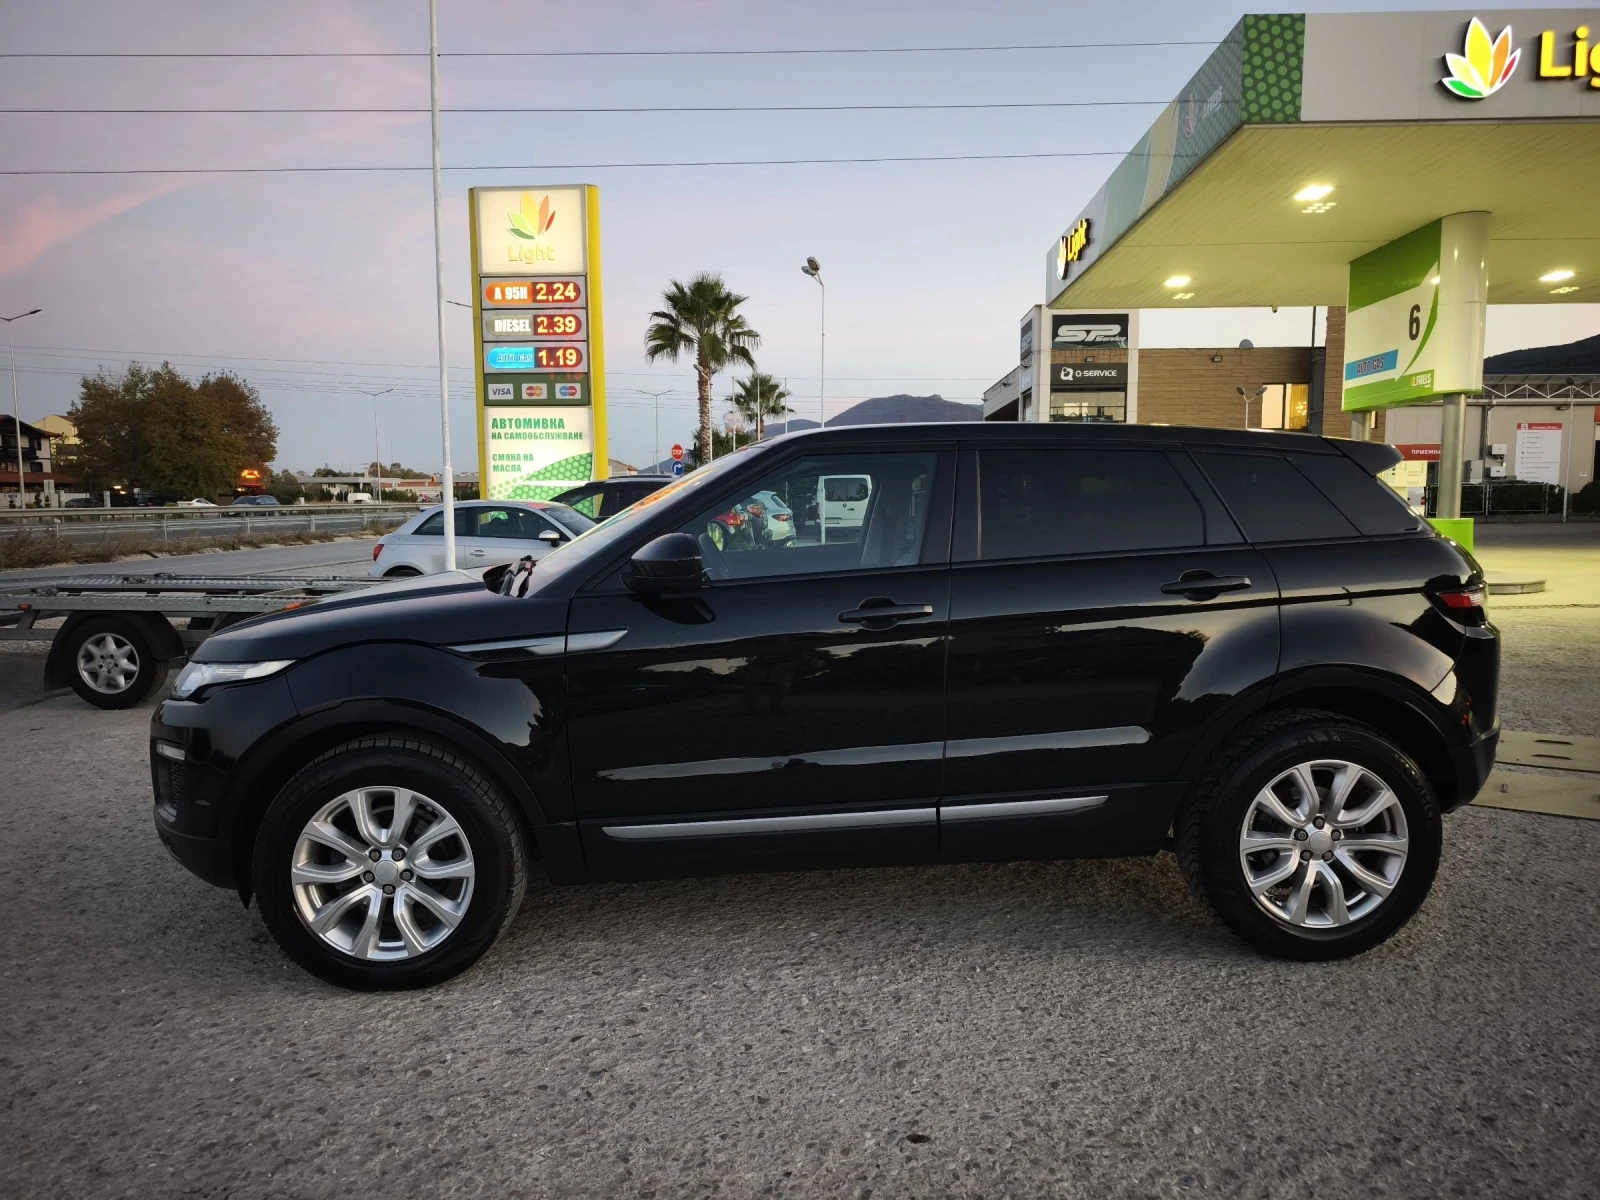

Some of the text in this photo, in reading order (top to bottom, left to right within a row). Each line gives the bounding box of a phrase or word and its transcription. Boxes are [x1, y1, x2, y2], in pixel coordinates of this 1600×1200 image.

[1067, 218, 1088, 262] Light
[507, 243, 556, 265] Light
[494, 316, 577, 333] DIESEL 2.39
[1408, 304, 1421, 341] 6
[1053, 324, 1122, 342] SP
[538, 348, 578, 366] 1.19
[1356, 357, 1384, 375] AUTO GAS
[492, 387, 512, 396] VISA
[491, 417, 566, 430] АВТОМИВКА
[491, 431, 584, 440] НА САМООБСЛУЖВАНЕ
[492, 453, 534, 462] СМЯНА НА
[492, 464, 522, 473] МАСЛА
